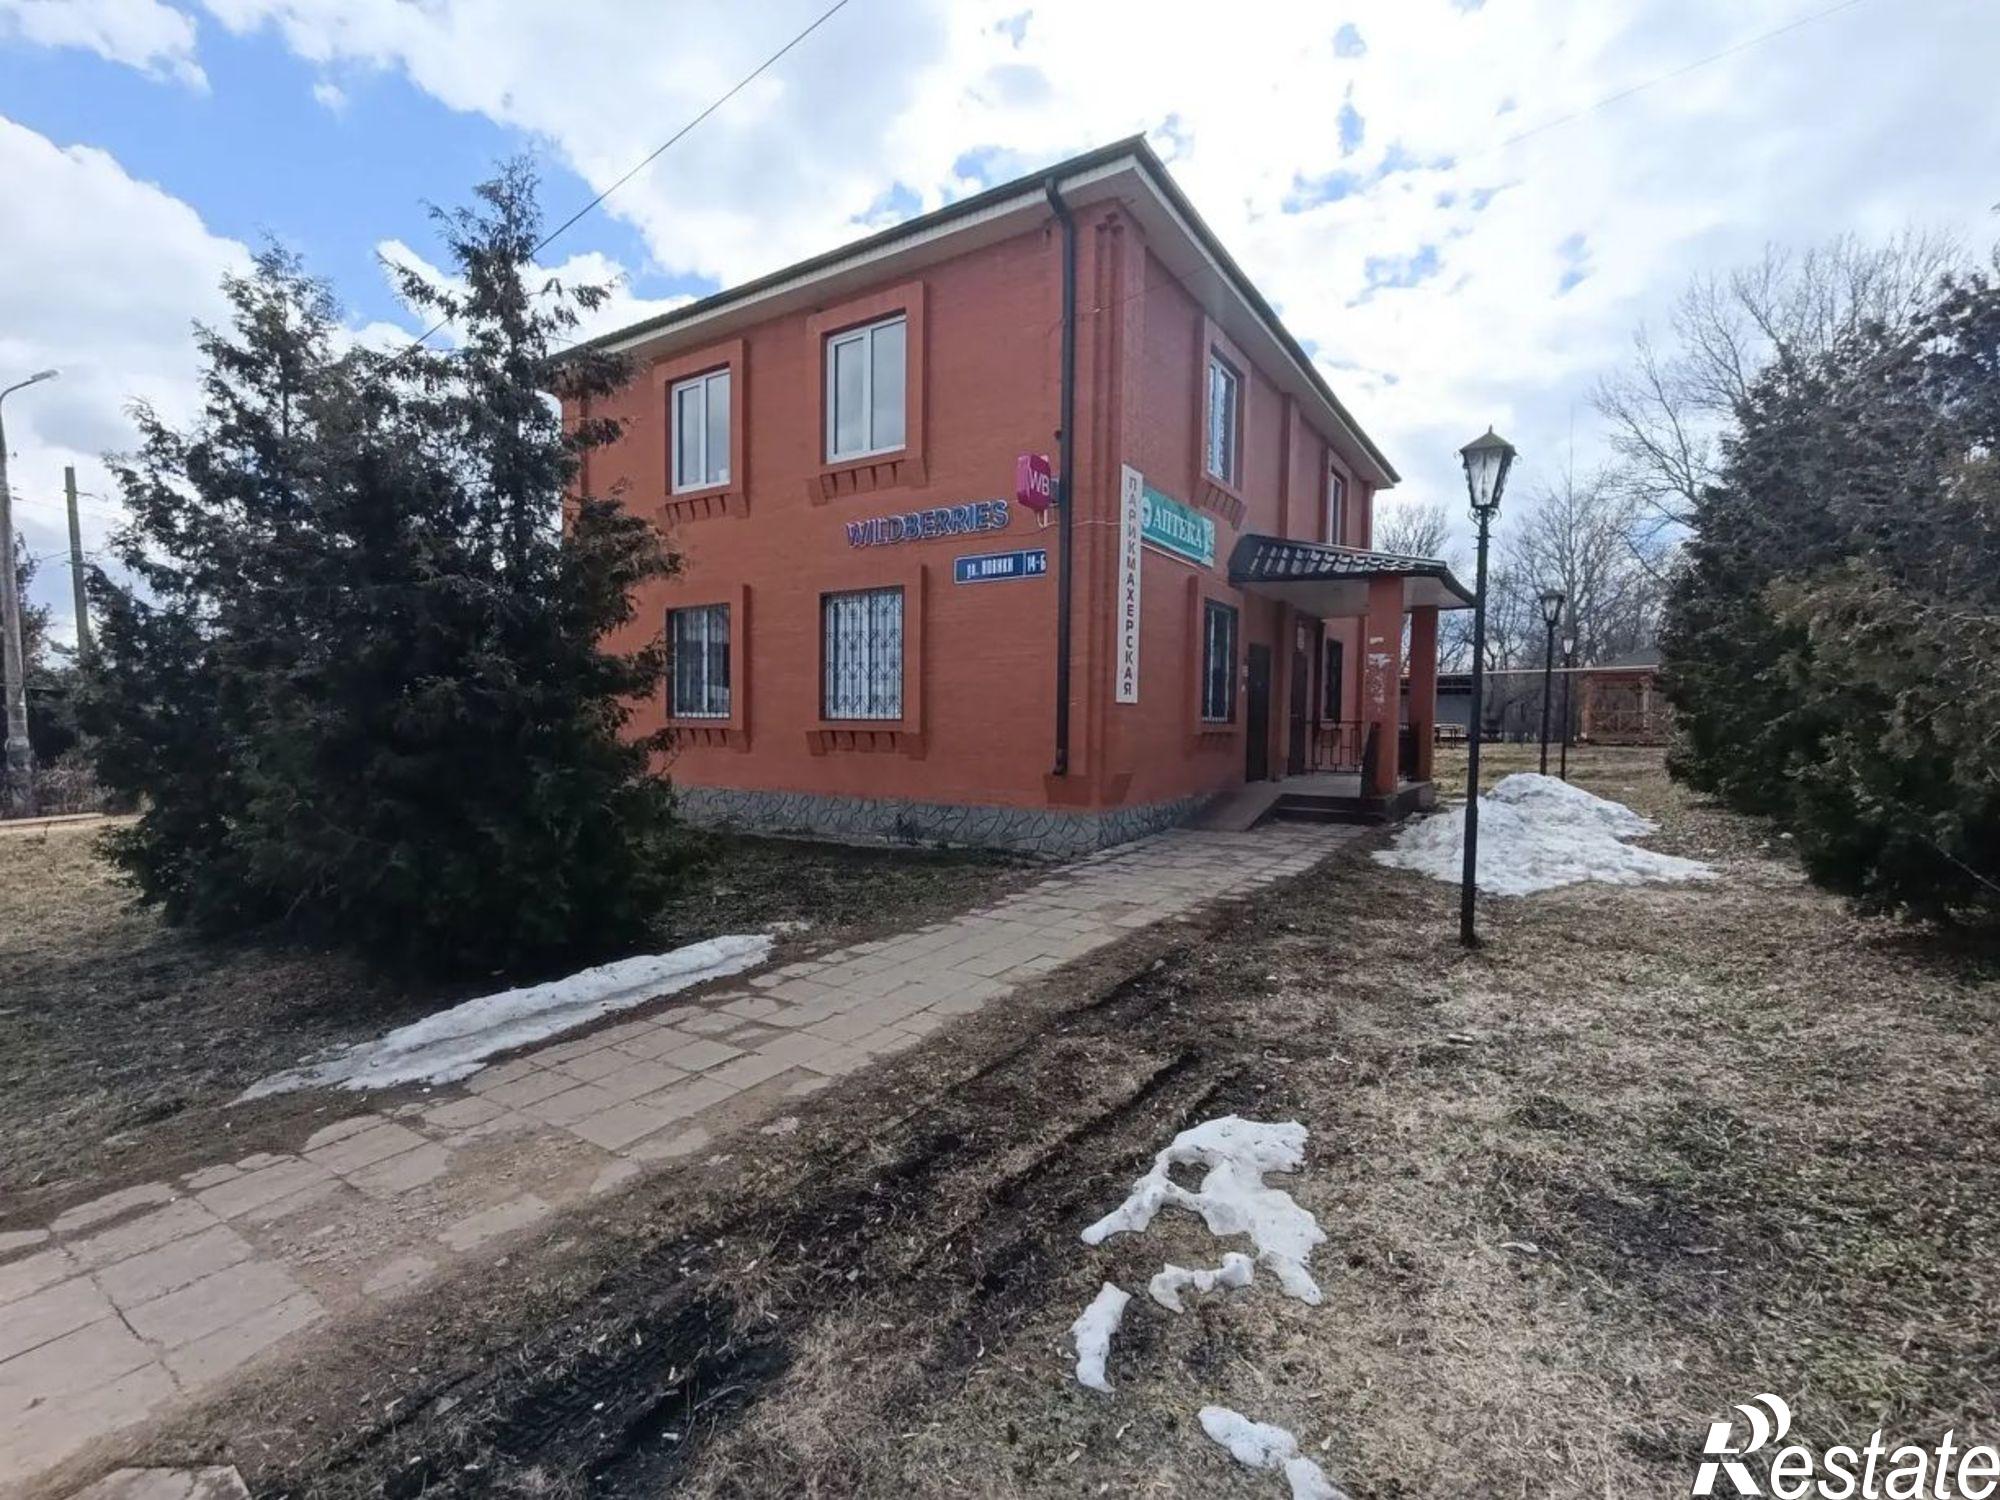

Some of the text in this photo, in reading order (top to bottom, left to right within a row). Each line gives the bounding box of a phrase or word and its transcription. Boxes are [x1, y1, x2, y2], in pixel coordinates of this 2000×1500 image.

[1029, 468, 1050, 496] WB
[847, 499, 1009, 548] WILDBERRIES
[1152, 504, 1202, 550] АПТЕКА
[1123, 476, 1137, 696] ПАРИКМАХЕРСКАЯ
